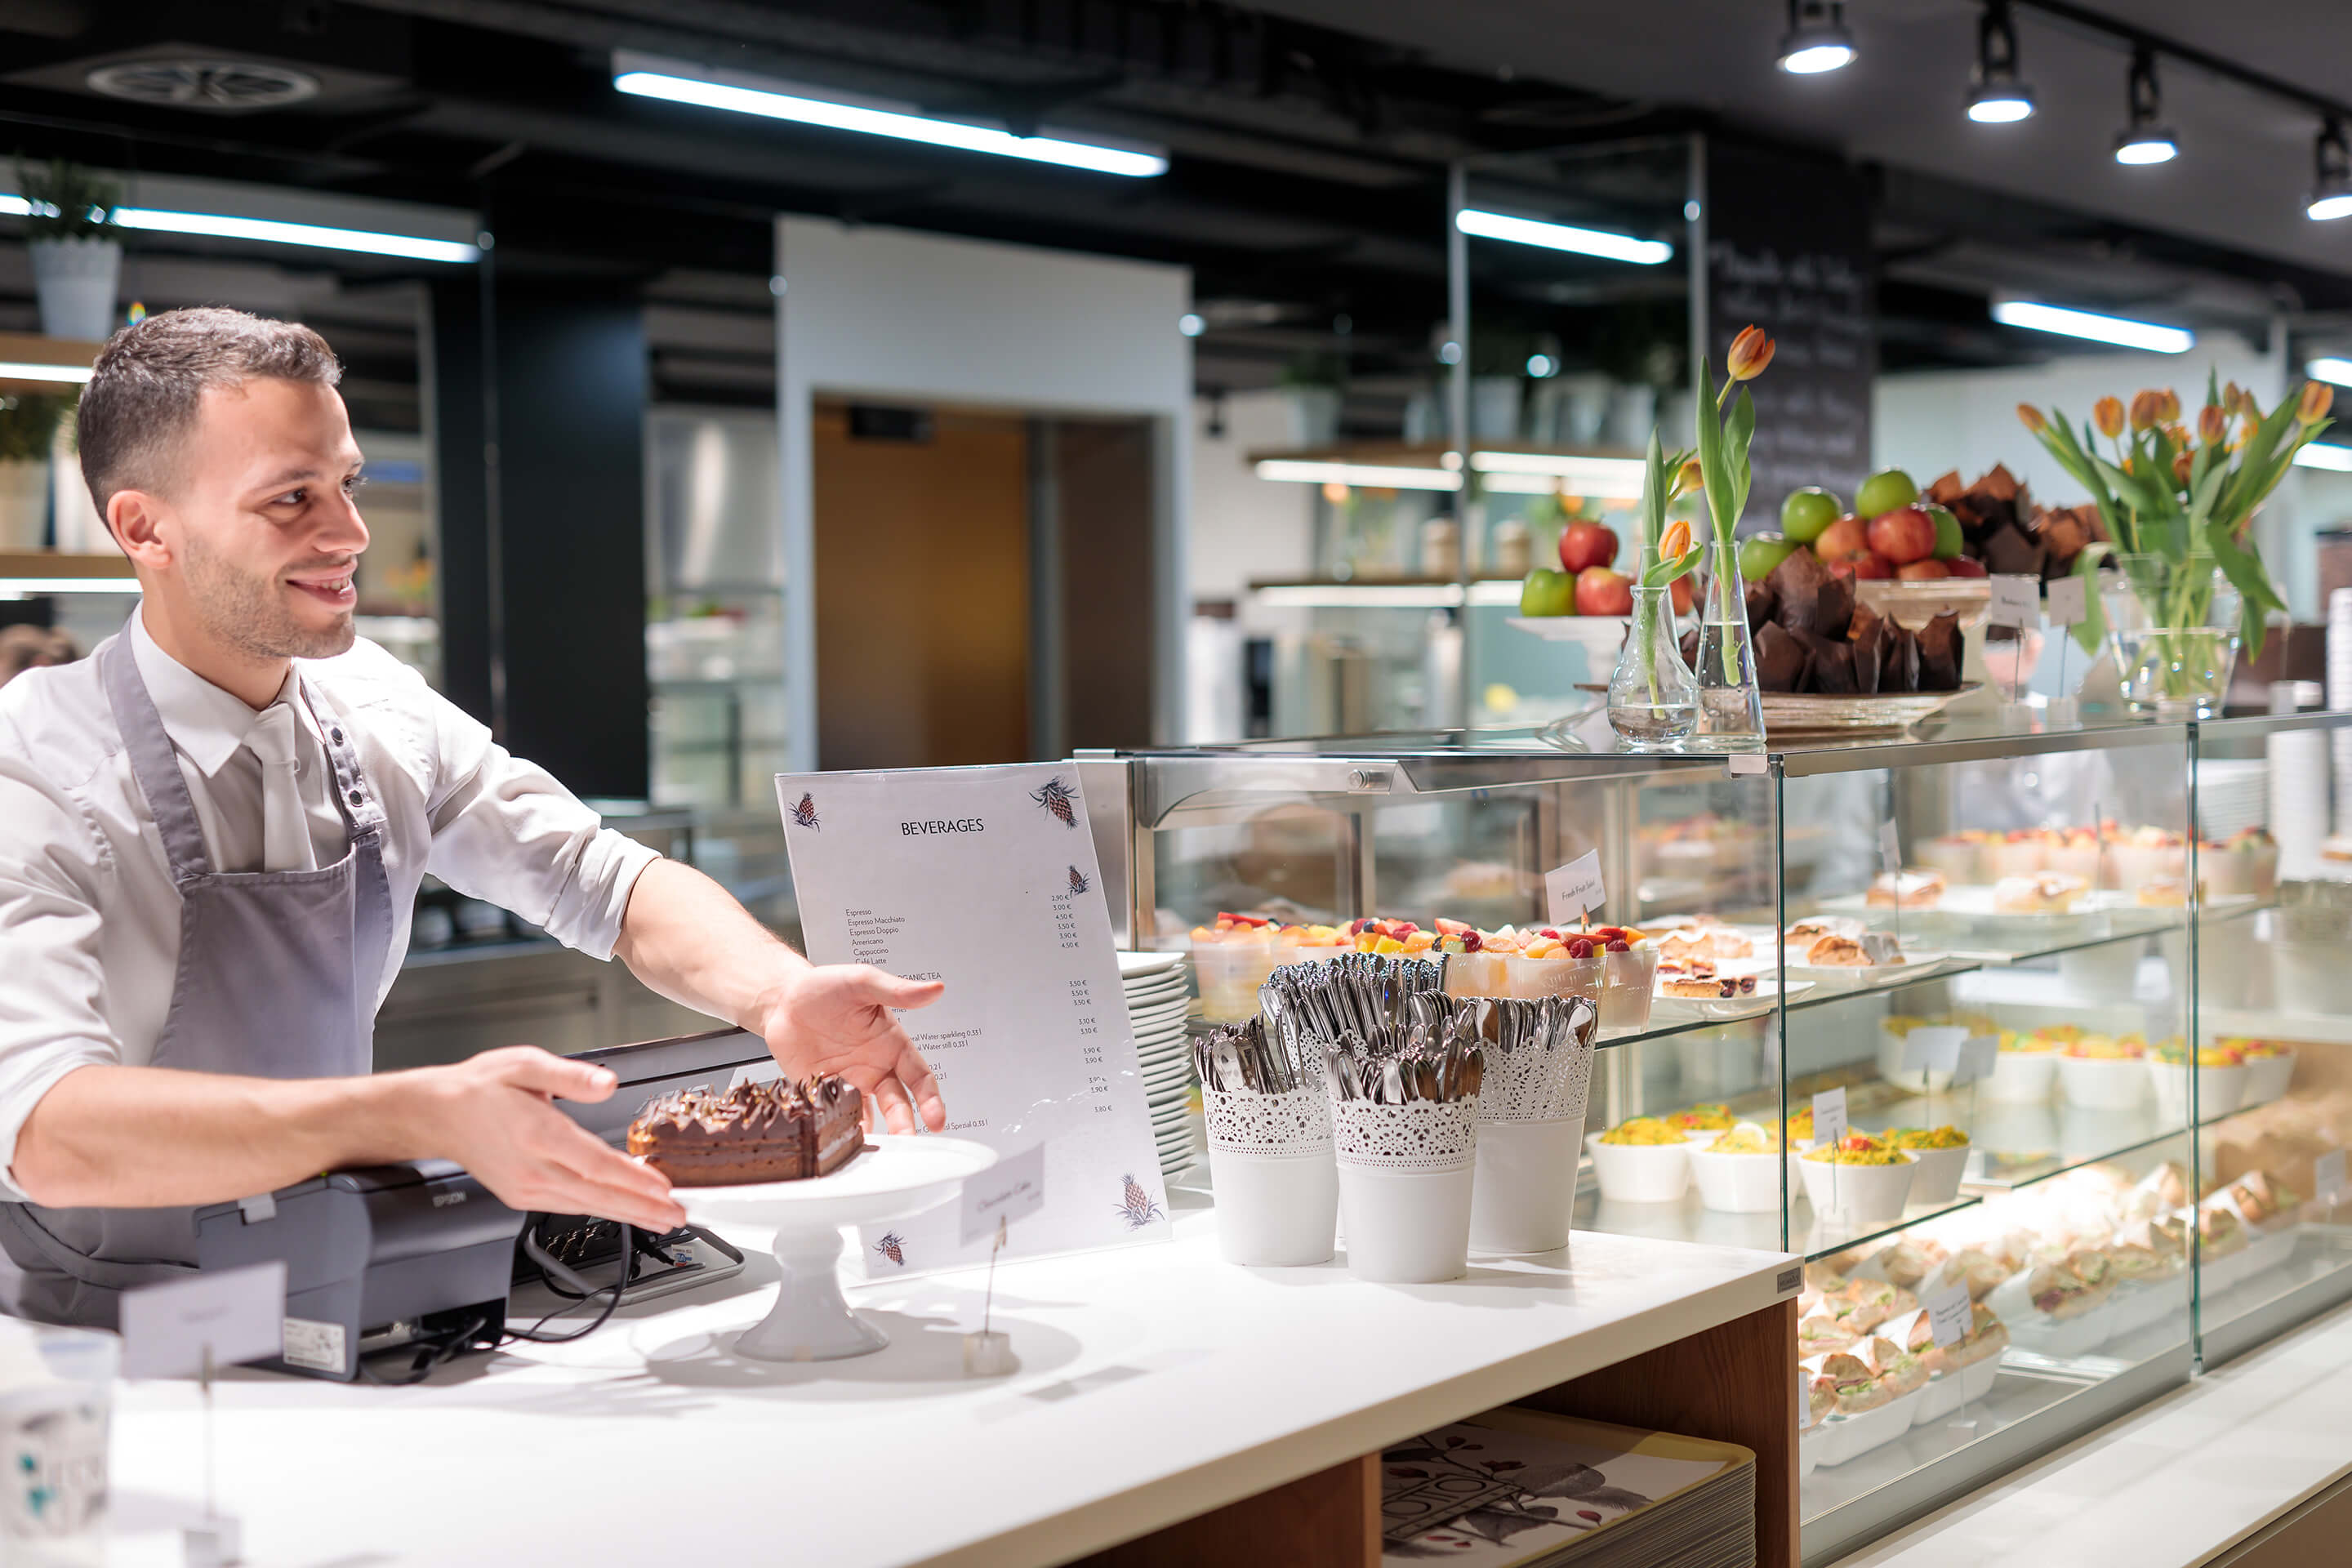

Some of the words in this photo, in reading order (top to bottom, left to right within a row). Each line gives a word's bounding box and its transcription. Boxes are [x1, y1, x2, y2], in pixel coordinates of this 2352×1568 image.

[901, 817, 984, 835] BEVERAGES
[1561, 887, 1576, 901] Fresh
[845, 908, 871, 917] Espresso
[847, 918, 873, 927] Espresso
[874, 915, 905, 924] Macchiato
[849, 928, 875, 937] Espresso
[875, 926, 899, 935] Doppio
[853, 947, 889, 956] Cappuccino
[927, 972, 942, 980] TEA
[920, 1032, 939, 1040] Water
[940, 1030, 966, 1040] sparkling
[922, 1043, 941, 1051] Water
[942, 1041, 952, 1049] still
[951, 1120, 972, 1131] Spezial
